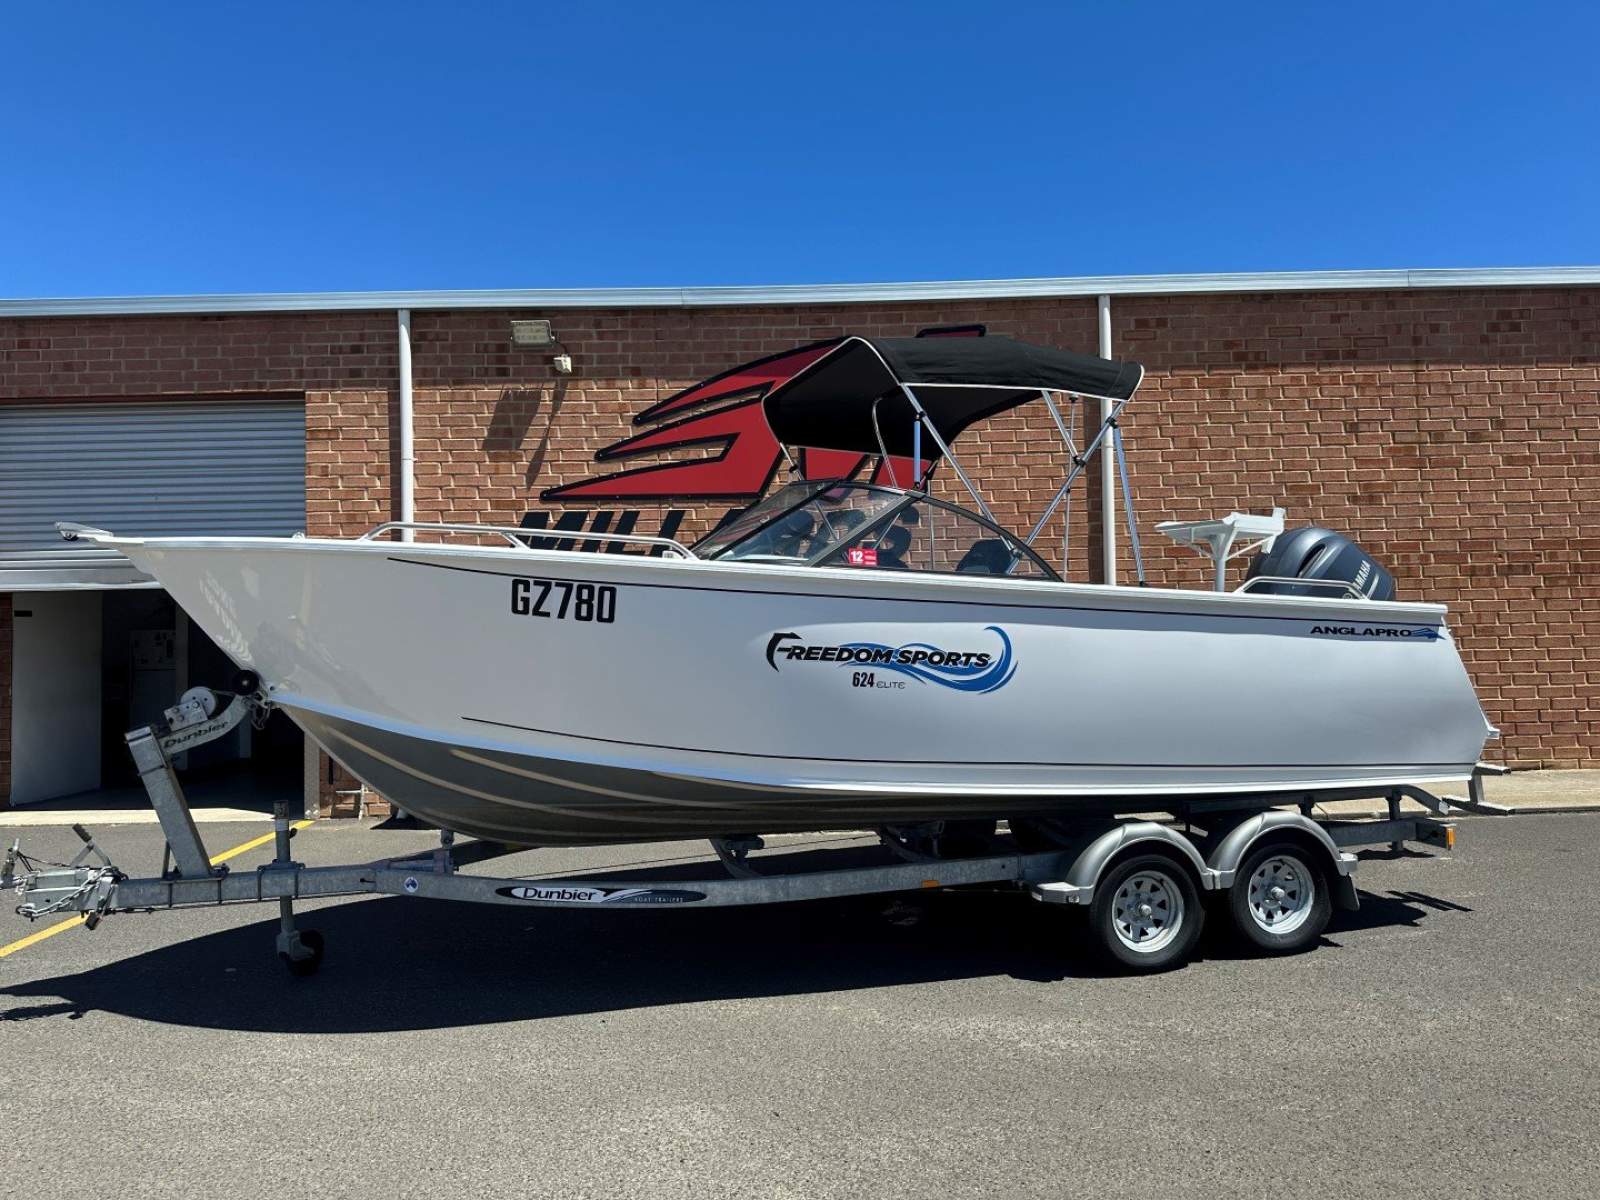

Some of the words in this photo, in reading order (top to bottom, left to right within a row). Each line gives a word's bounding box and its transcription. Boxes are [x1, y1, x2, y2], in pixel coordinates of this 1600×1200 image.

[511, 578, 617, 624] GZ780
[1310, 625, 1412, 638] ANGLAPRO
[766, 631, 891, 673] FREEDOM
[898, 649, 992, 668] SPORTS
[852, 671, 875, 688] 624
[876, 680, 906, 690] ELITE
[164, 721, 230, 748] Dunbier
[522, 887, 598, 901] Dunbier
